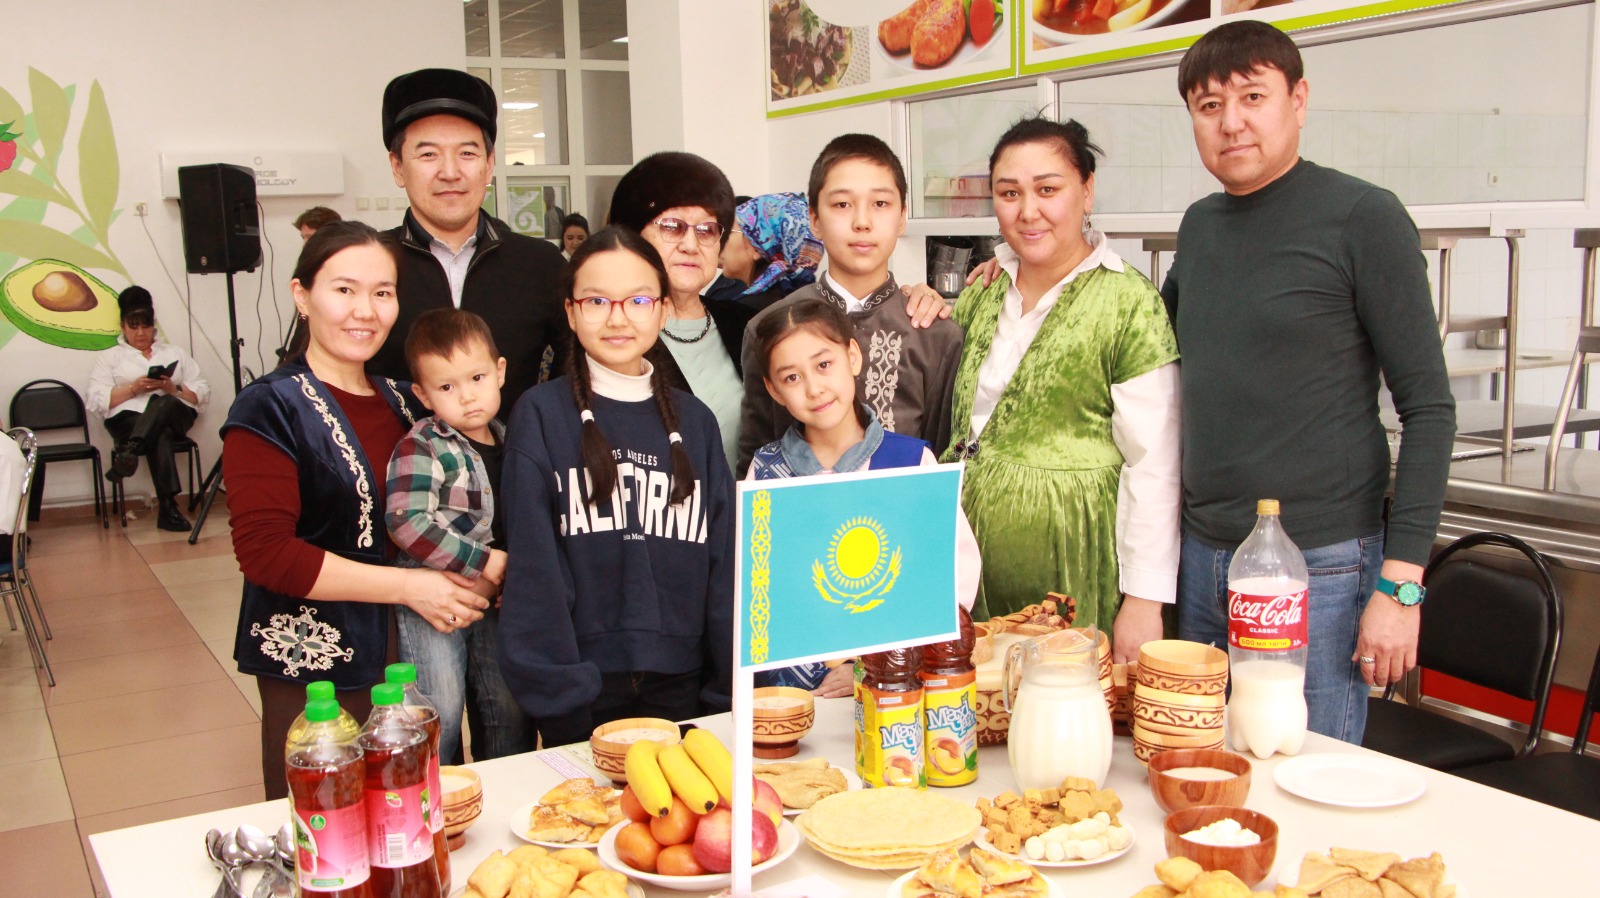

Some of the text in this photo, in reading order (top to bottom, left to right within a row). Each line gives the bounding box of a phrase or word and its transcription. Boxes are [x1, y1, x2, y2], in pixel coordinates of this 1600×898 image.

[611, 448, 658, 466] OS ANGELES
[1228, 592, 1304, 626] Coca-Cola
[1241, 638, 1255, 646] 500
